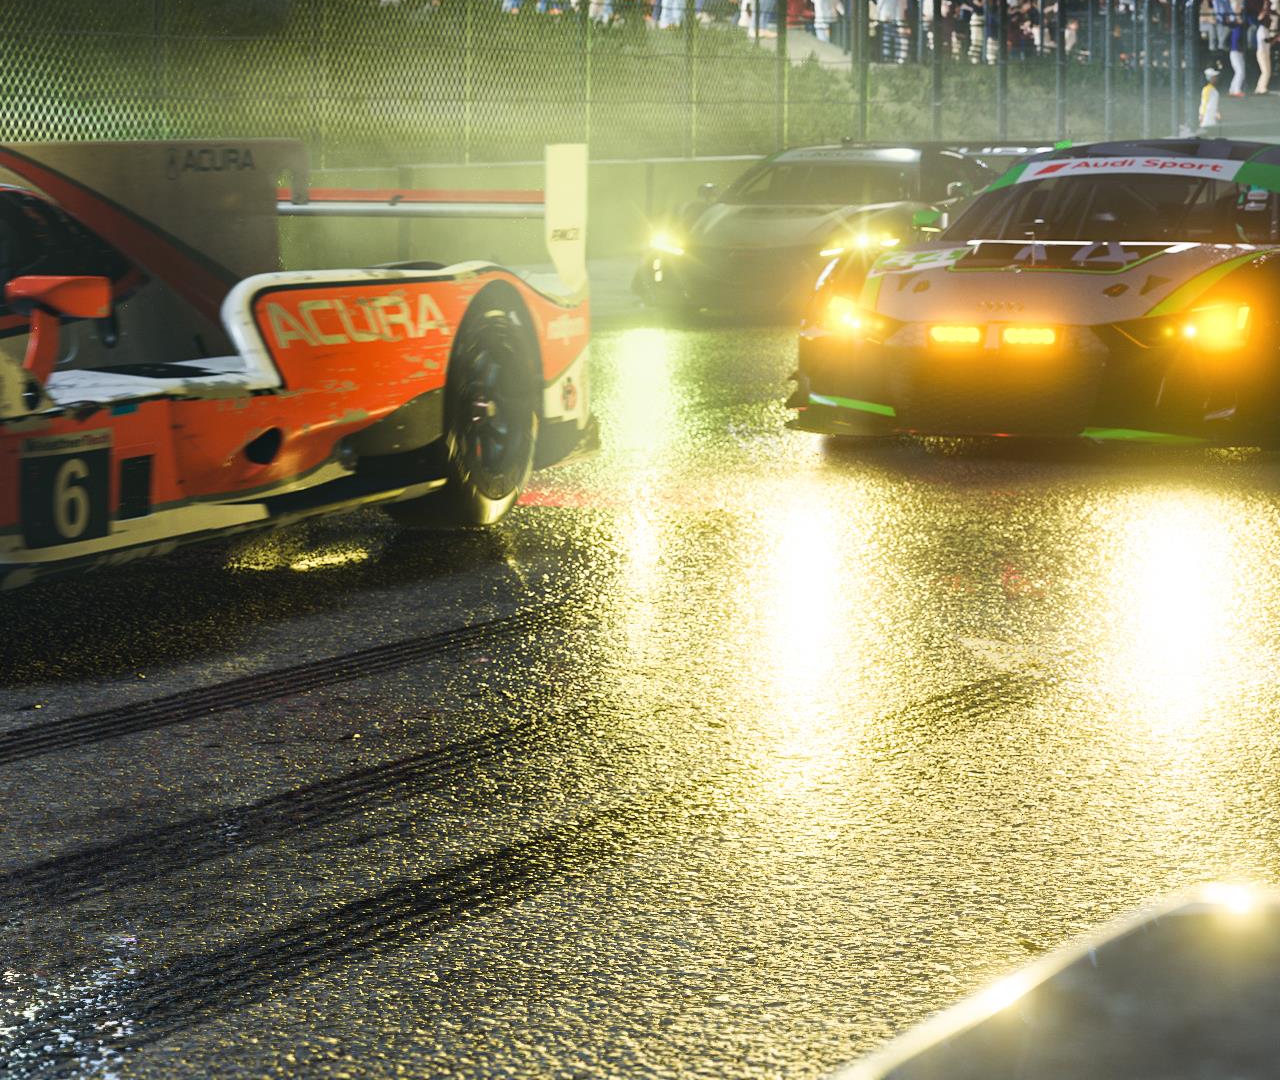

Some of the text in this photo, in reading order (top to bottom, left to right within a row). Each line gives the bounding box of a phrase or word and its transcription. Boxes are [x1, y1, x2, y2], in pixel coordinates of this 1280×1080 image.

[184, 148, 256, 172] ACURA
[1072, 158, 1224, 173] Audi Sport
[265, 293, 453, 349] ACURA
[53, 457, 91, 539] 6
